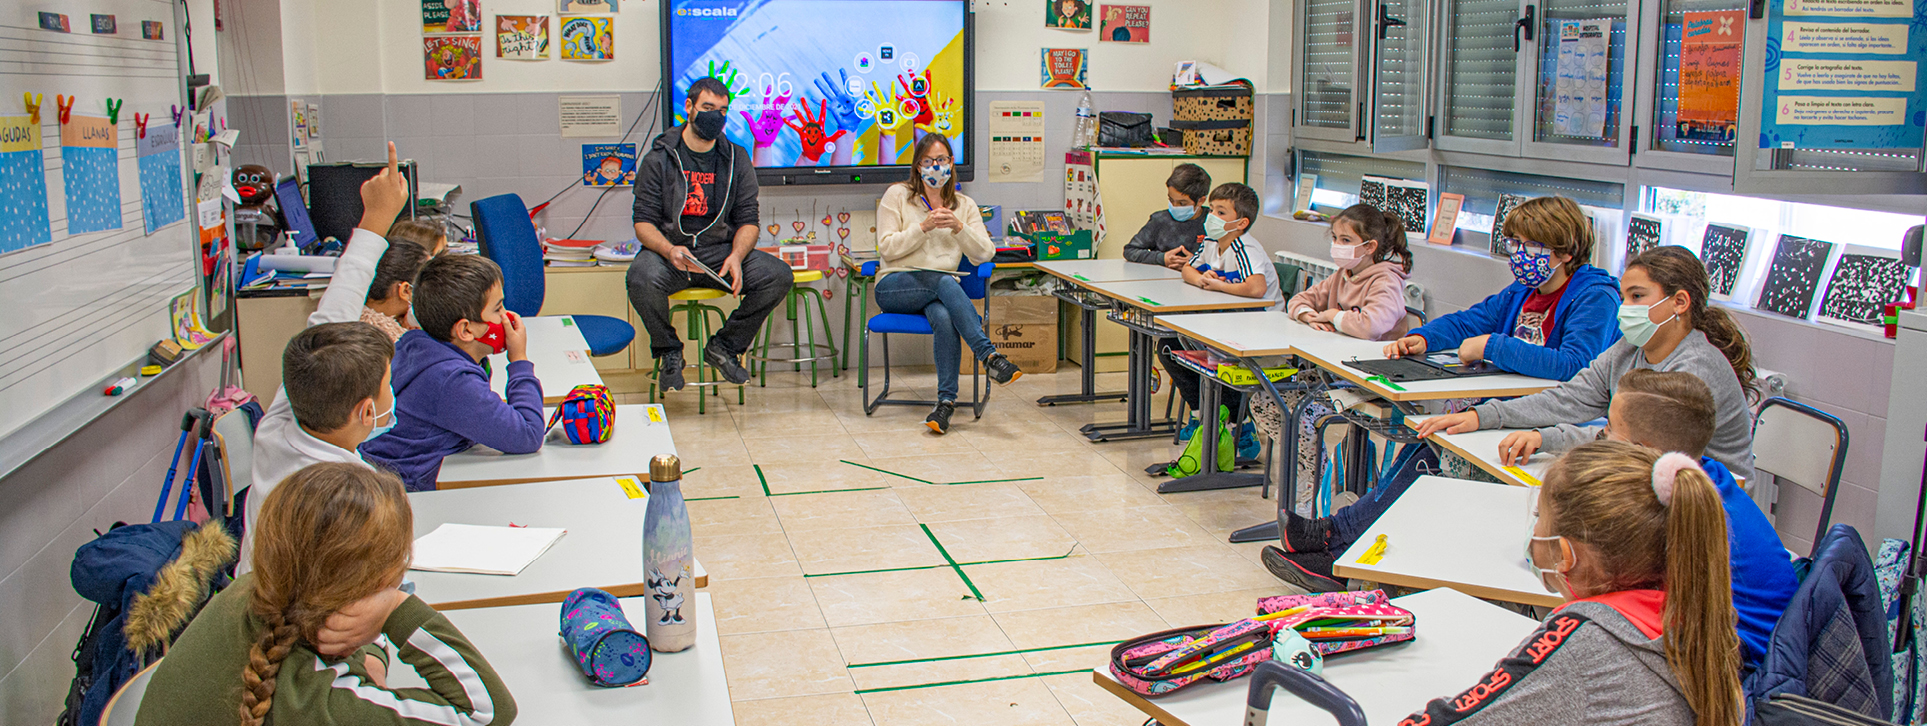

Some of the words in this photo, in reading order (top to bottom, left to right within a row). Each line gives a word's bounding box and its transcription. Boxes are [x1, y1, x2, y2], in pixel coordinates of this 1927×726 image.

[1787, 30, 1794, 42] 4
[423, 37, 449, 53] LET'S
[451, 37, 480, 54] SING!
[1784, 68, 1792, 80] 5
[1782, 104, 1789, 115] 6
[82, 126, 109, 140] LLANAS
[1526, 616, 1580, 664] SPORT
[1455, 667, 1512, 712] SPORT
